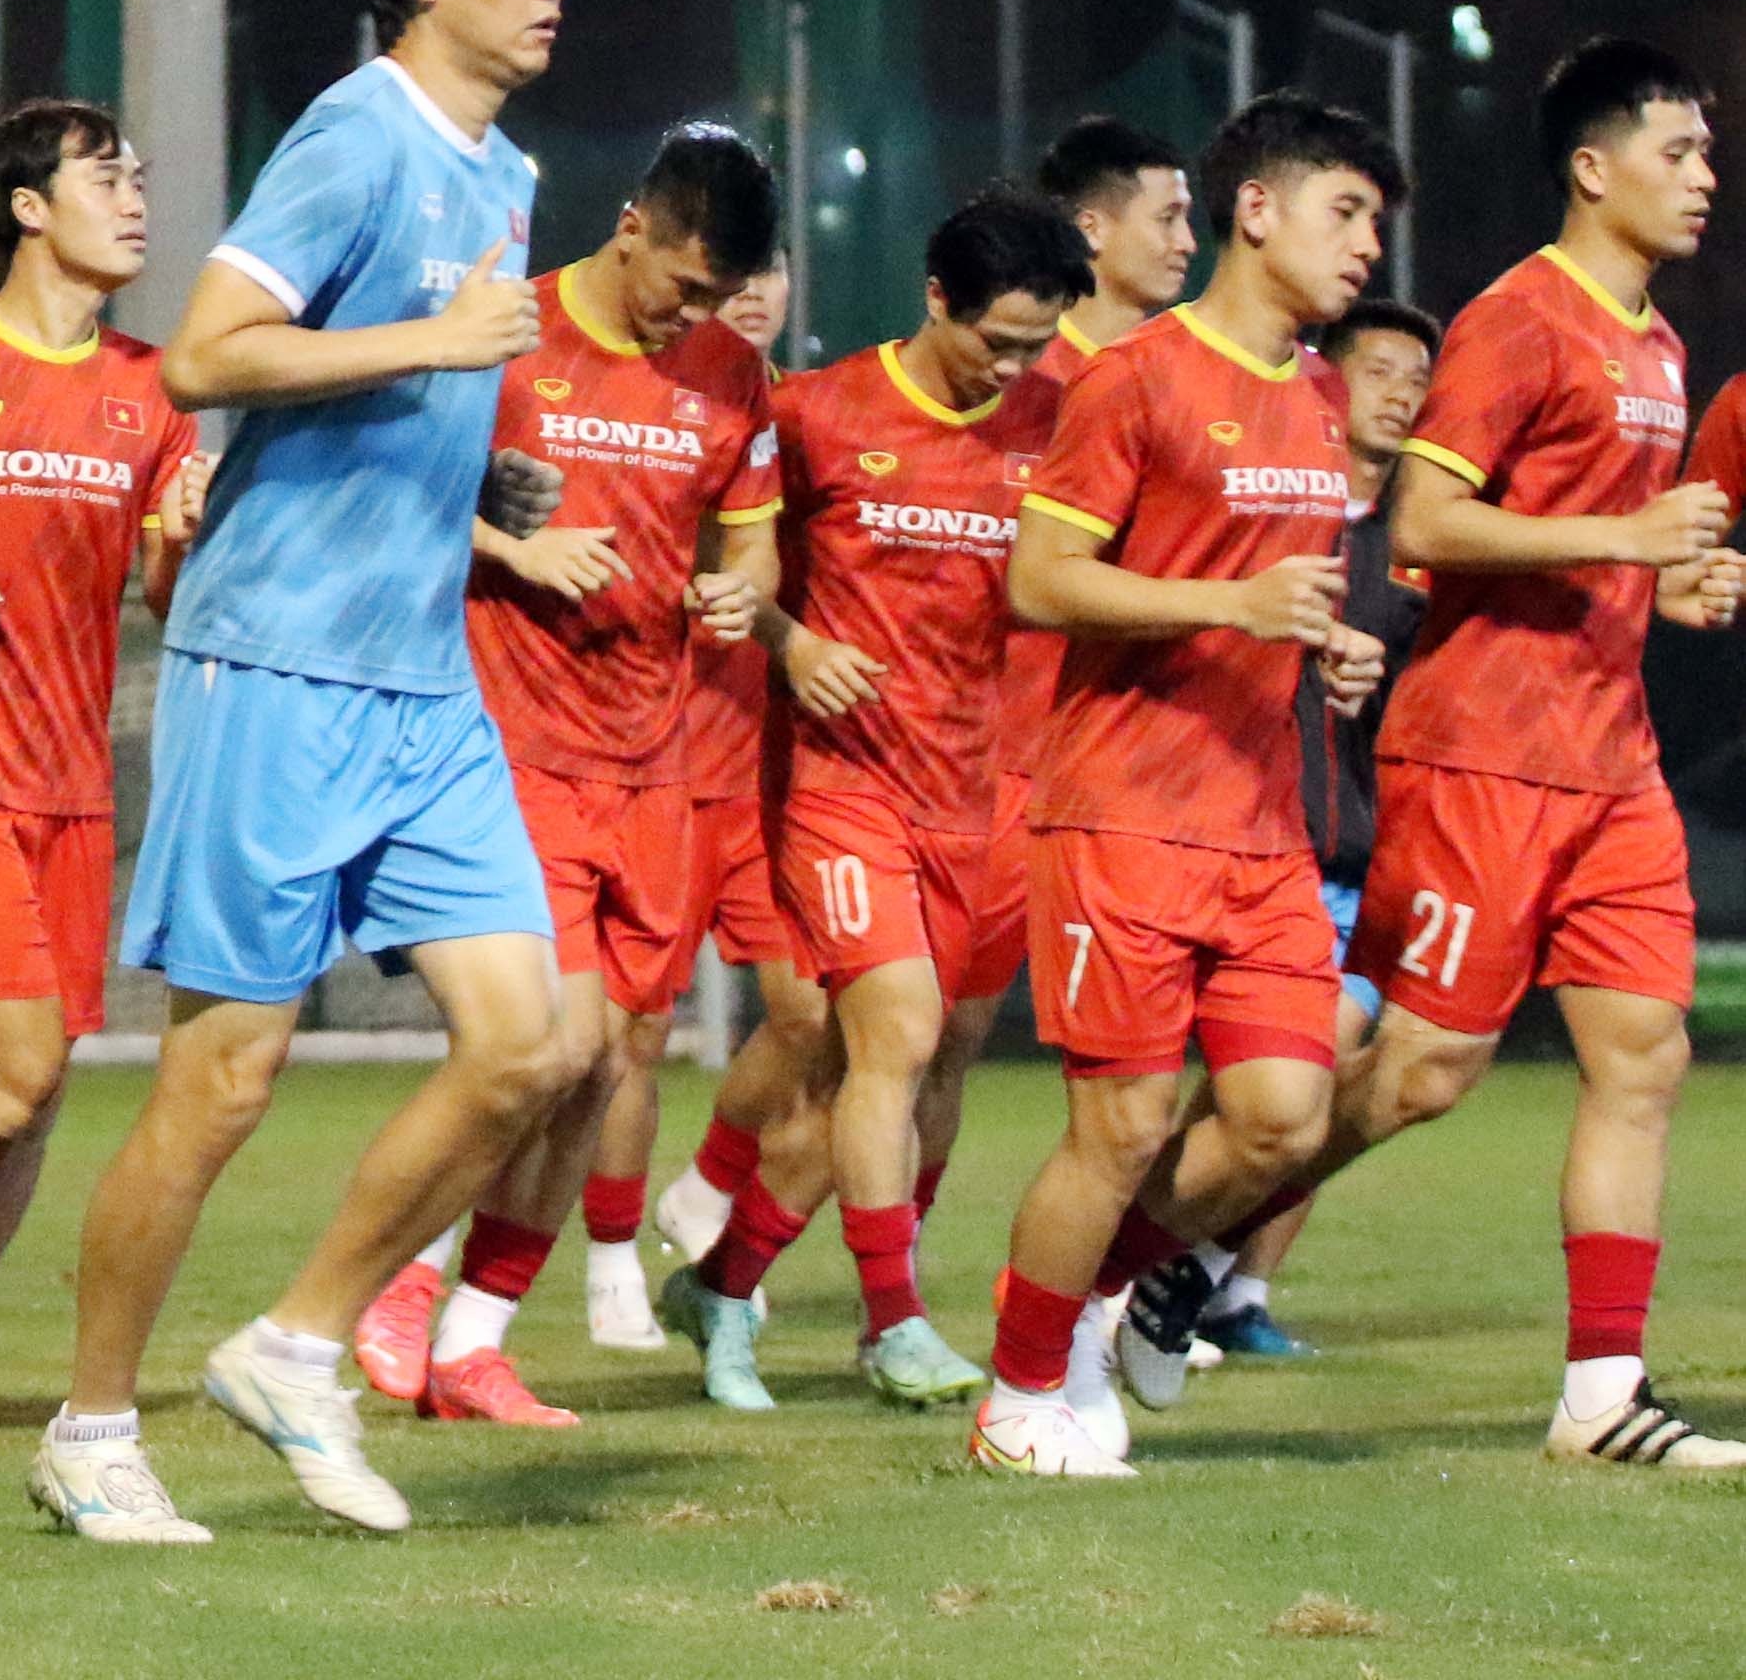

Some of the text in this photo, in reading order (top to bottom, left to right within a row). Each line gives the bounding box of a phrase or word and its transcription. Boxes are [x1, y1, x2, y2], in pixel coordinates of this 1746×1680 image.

[539, 413, 703, 457] HONDA
[546, 443, 696, 475] The Power of Dreams
[72, 486, 121, 507] Dreams
[1222, 467, 1349, 498] HONDA
[857, 500, 1019, 542] HONDA
[1228, 501, 1257, 514] The
[869, 531, 896, 545] The
[814, 854, 872, 937] 10
[1398, 889, 1476, 988] 21
[1063, 922, 1094, 1008] 7
